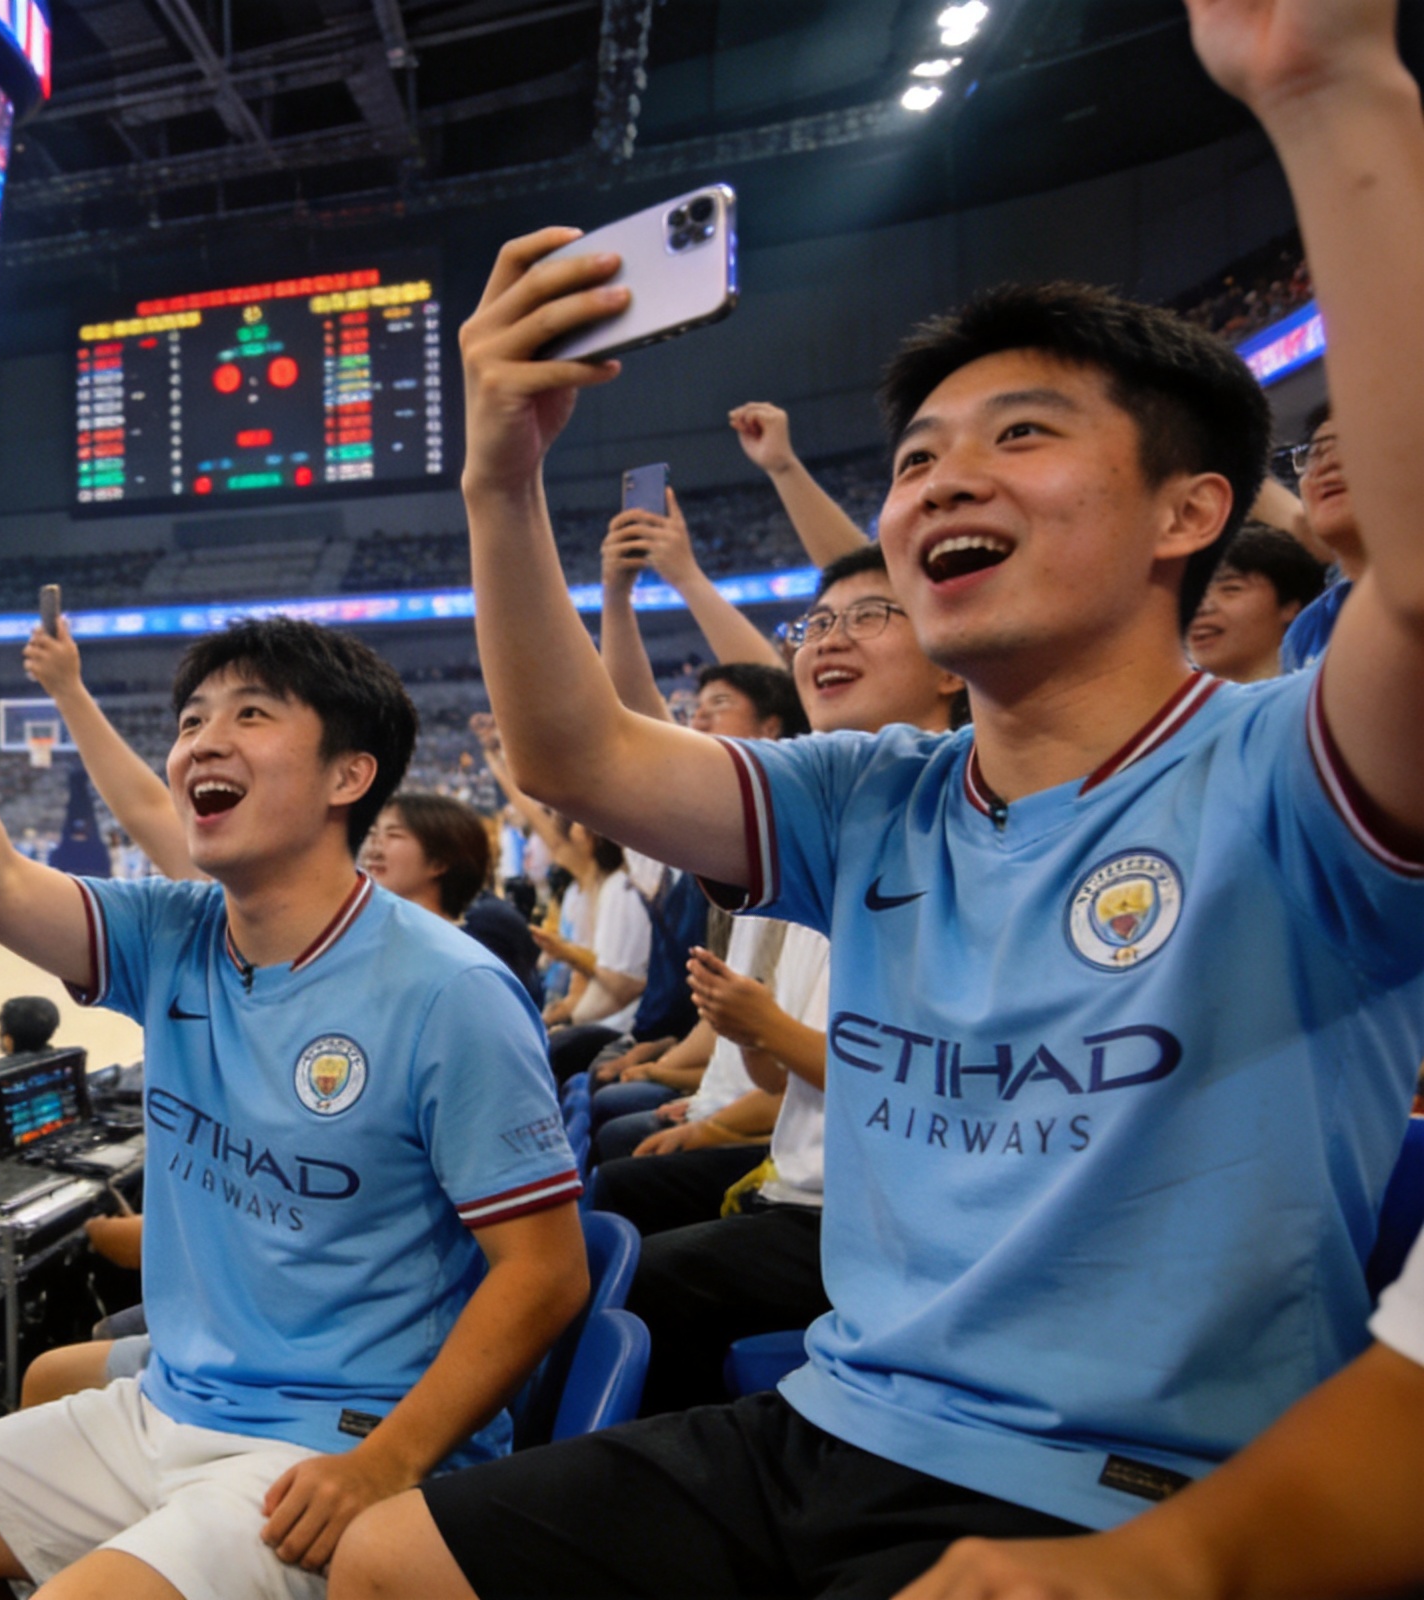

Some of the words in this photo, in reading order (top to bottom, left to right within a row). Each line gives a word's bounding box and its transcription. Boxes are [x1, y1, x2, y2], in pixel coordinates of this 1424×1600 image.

[829, 1011, 1182, 1101] ETIHAD
[147, 1087, 360, 1200] ETIHAD
[865, 1098, 1091, 1154] AIRWAYS
